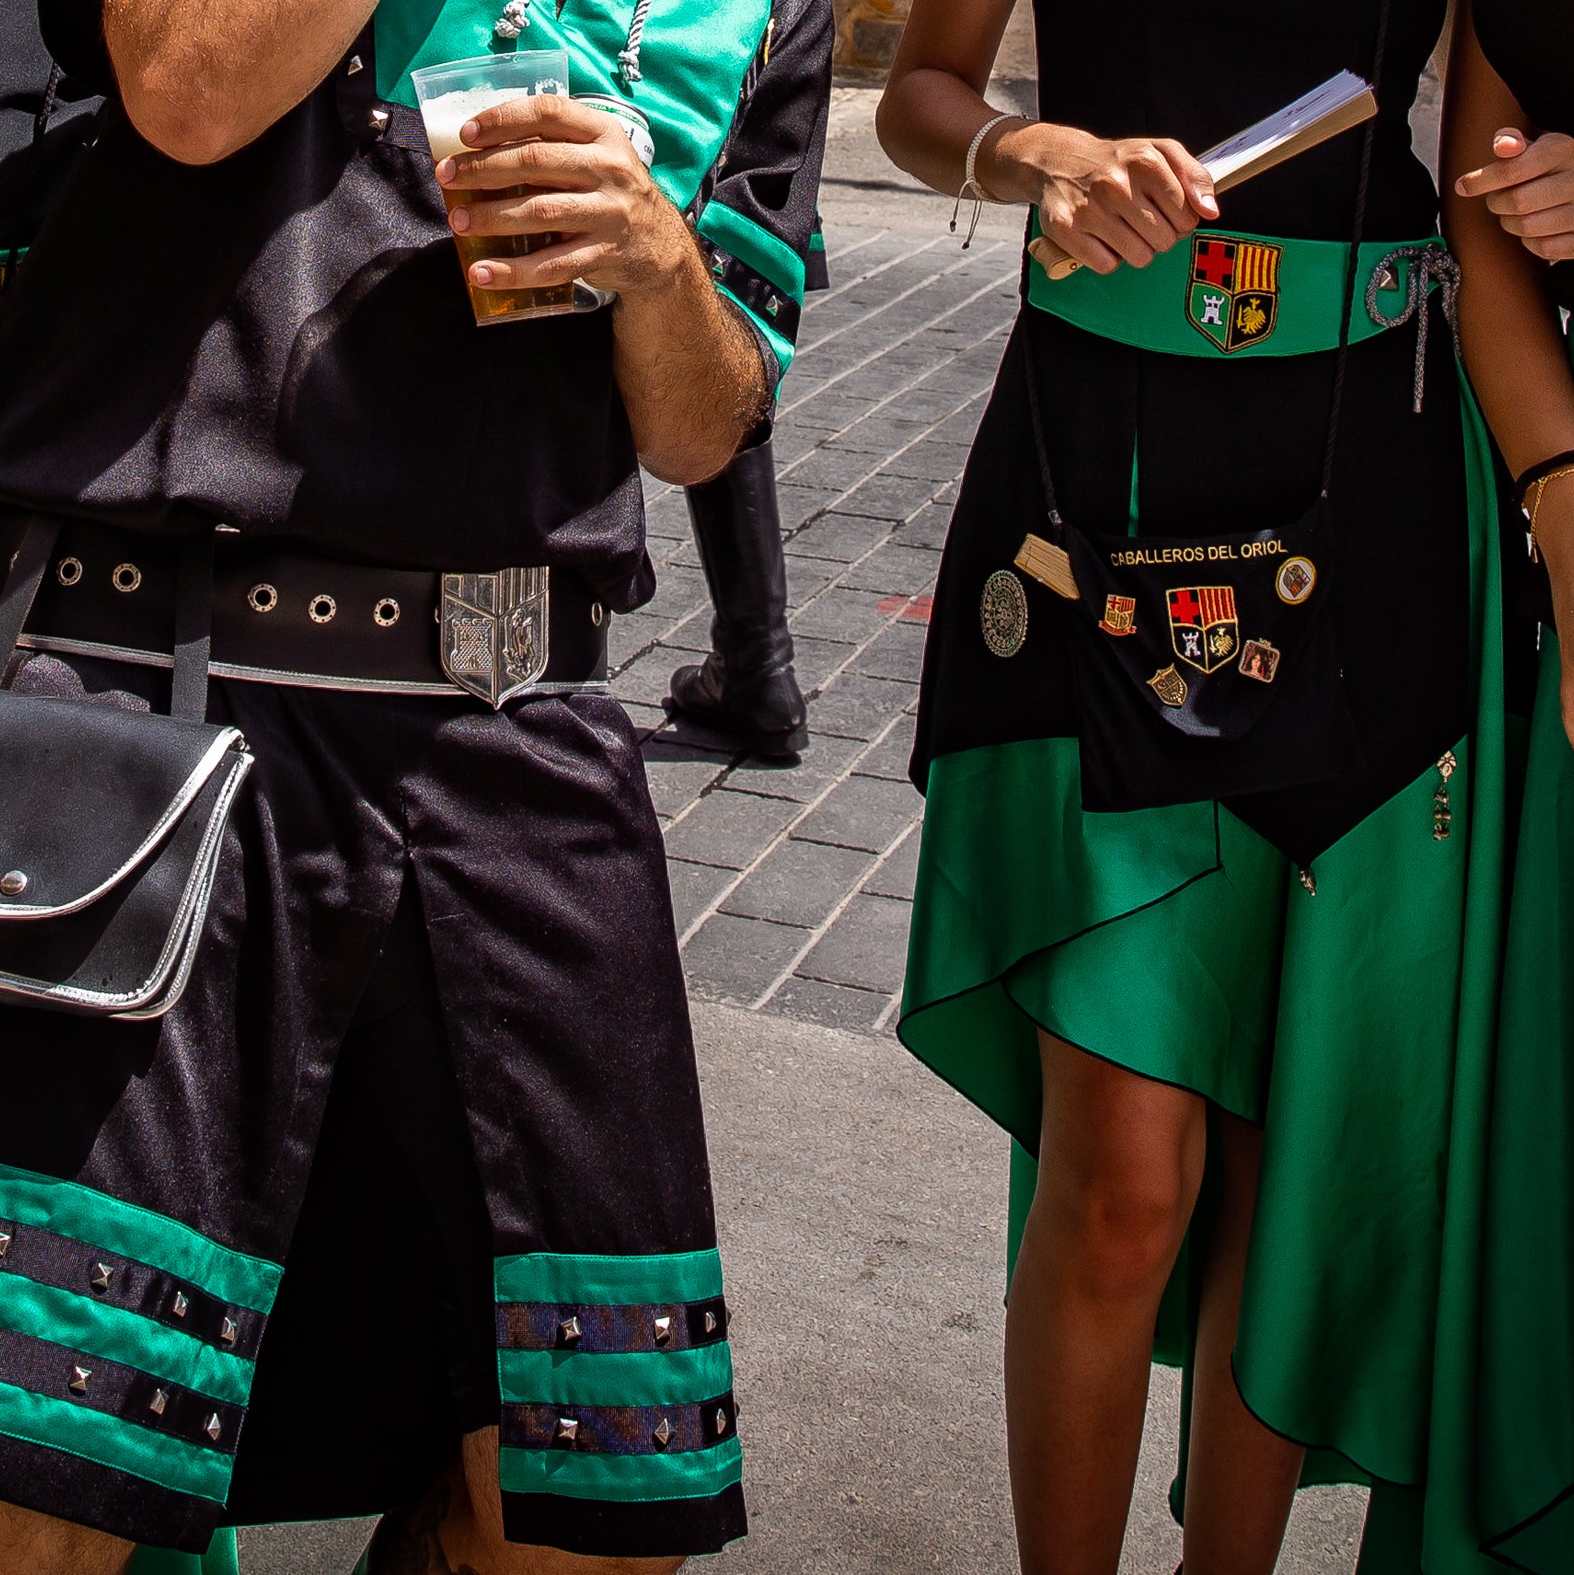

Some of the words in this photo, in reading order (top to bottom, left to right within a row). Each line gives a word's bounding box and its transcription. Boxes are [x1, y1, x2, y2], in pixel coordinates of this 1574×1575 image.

[1110, 547, 1205, 567] CABALLEROS
[1208, 544, 1239, 561] DEL
[1240, 539, 1289, 558] ORIOL
